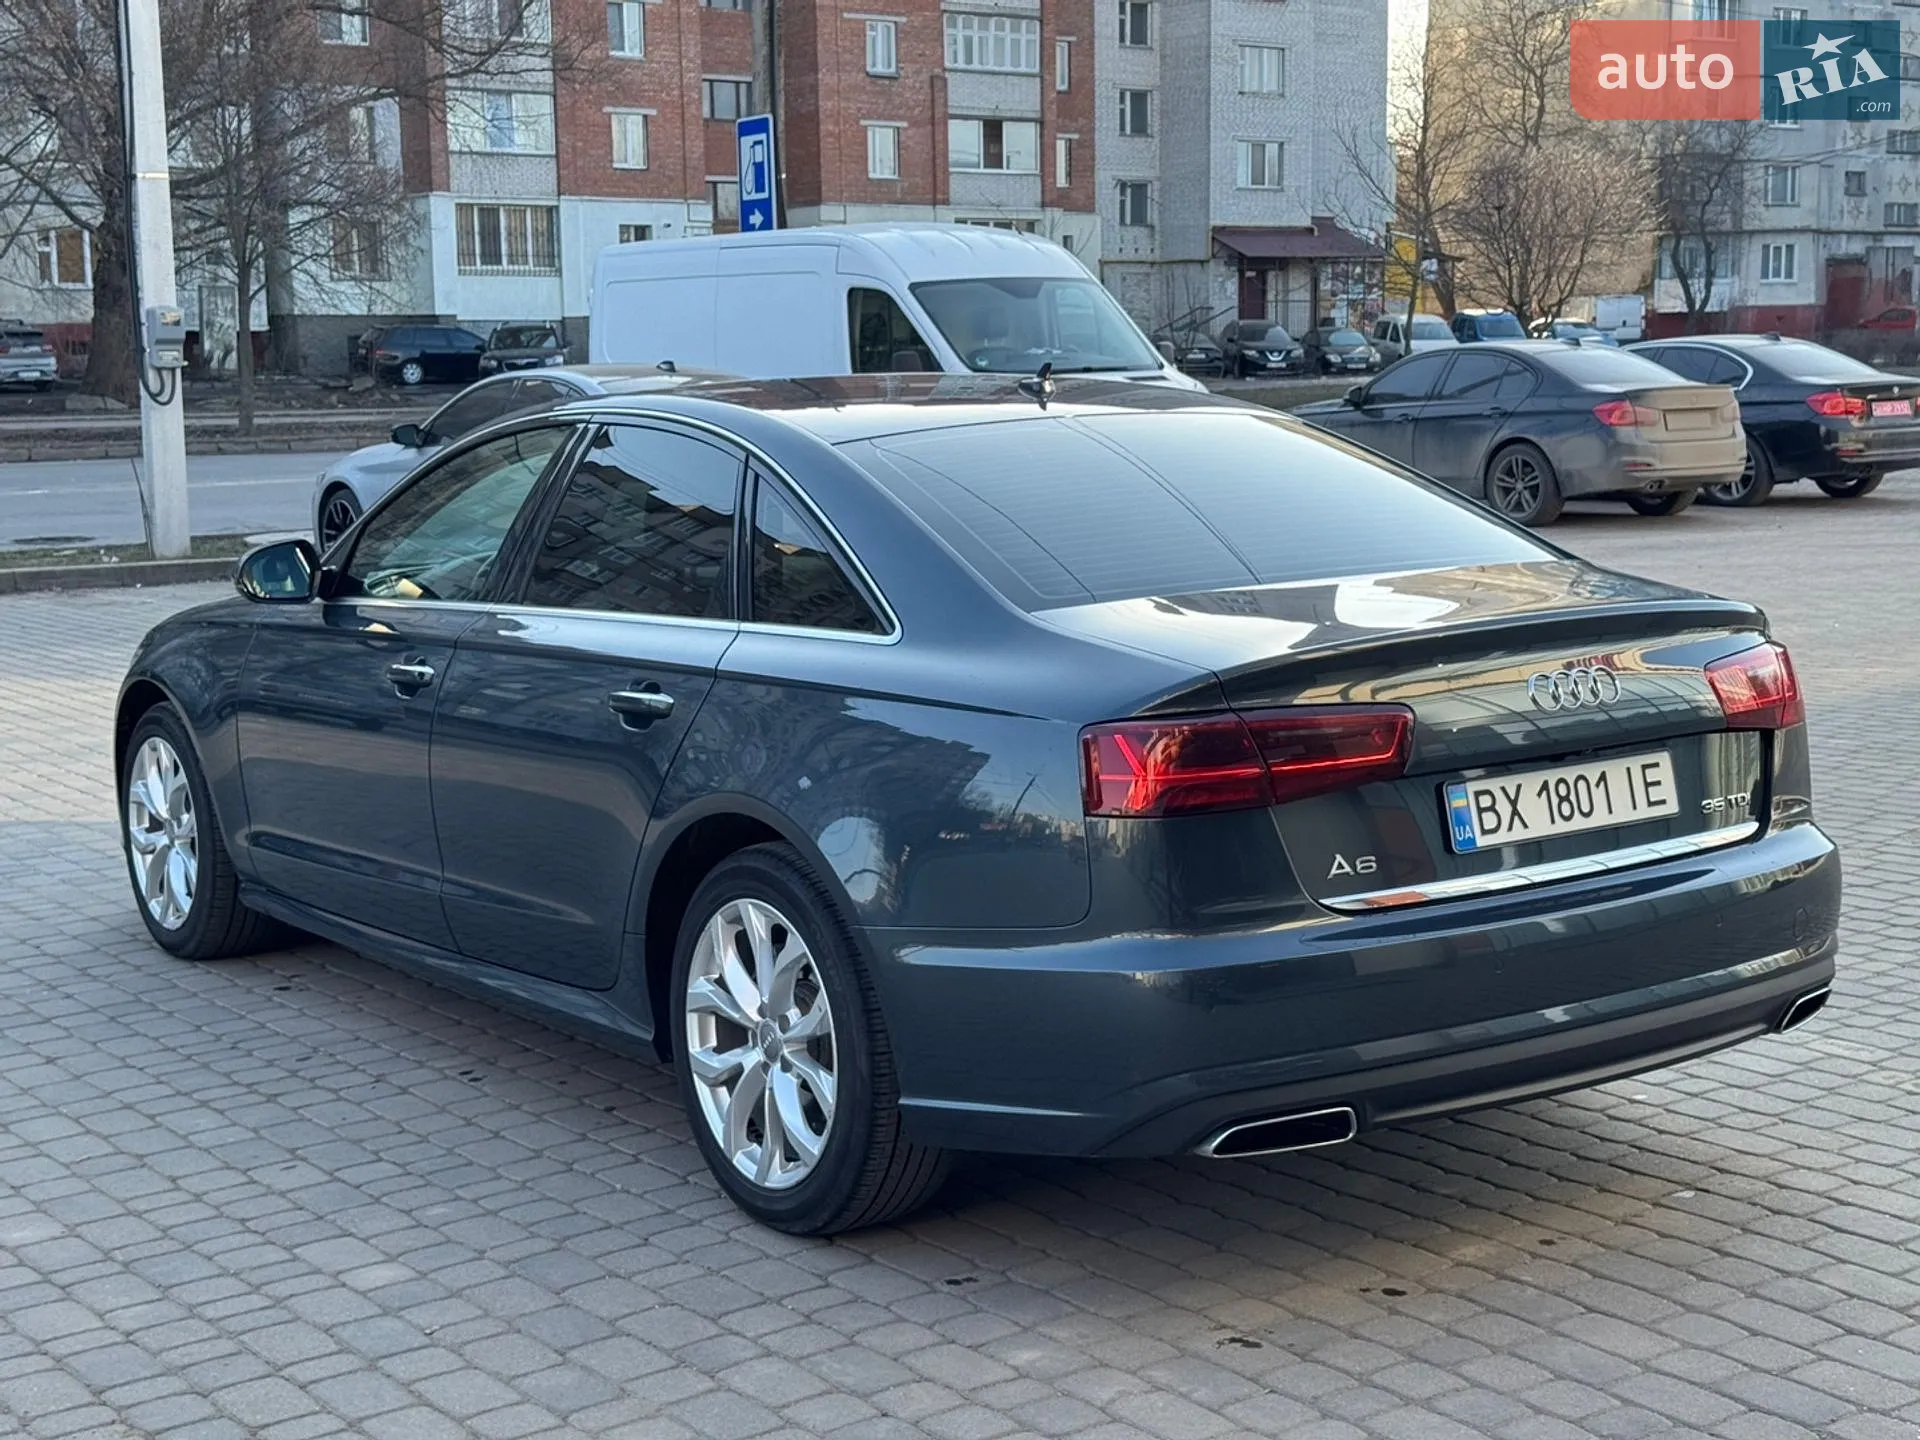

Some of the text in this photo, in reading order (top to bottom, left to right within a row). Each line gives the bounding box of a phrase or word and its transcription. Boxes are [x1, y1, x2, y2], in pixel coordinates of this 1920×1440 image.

[1473, 762, 1668, 837] BX 1801 IE
[1455, 824, 1474, 841] UA
[1327, 853, 1377, 881] A6
